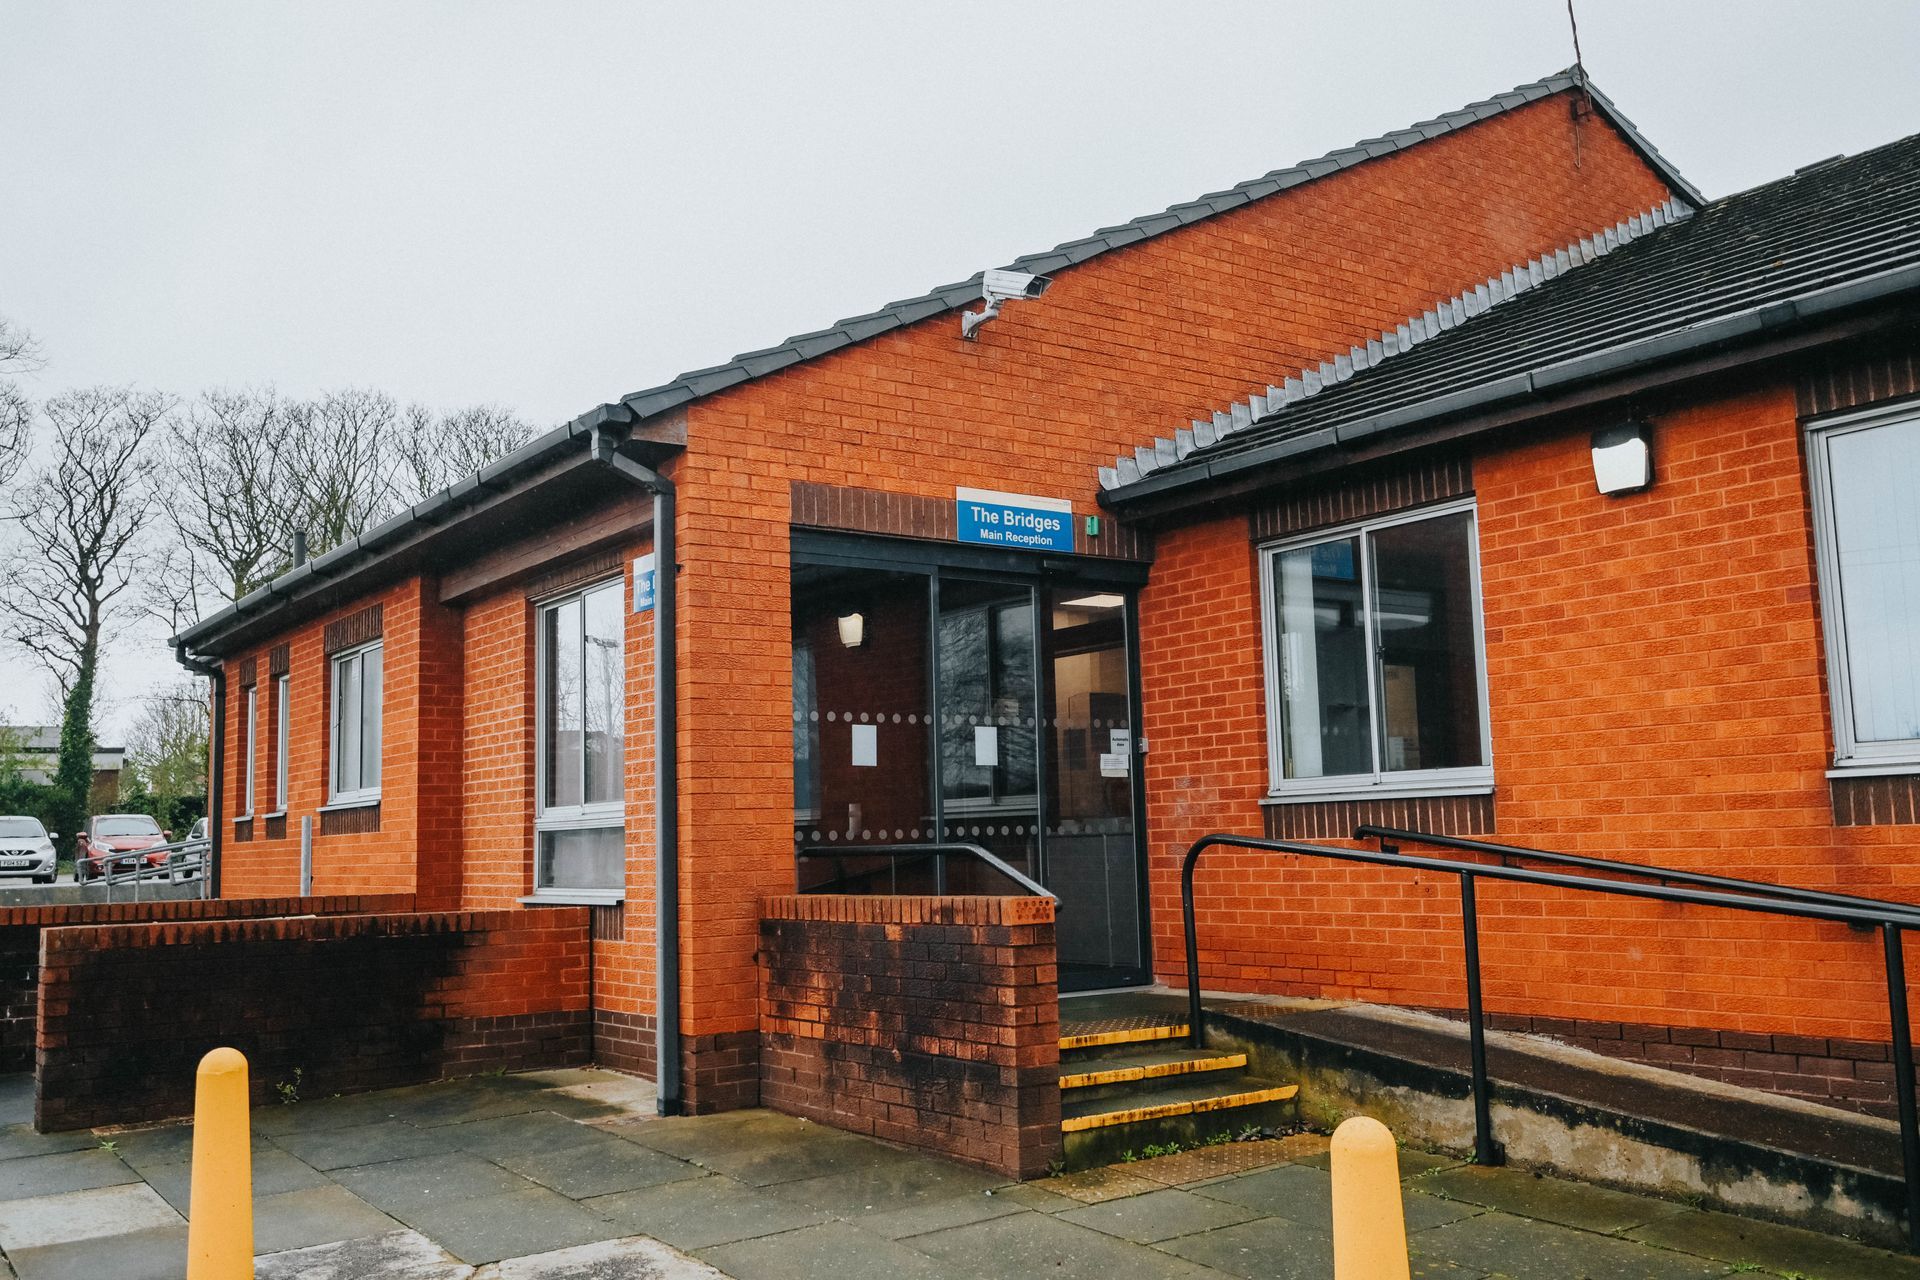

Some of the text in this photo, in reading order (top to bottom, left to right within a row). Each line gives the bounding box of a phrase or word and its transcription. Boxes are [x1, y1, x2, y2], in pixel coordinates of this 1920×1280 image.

[970, 506, 1061, 532] The Bridges
[980, 529, 1053, 546] Main Reception
